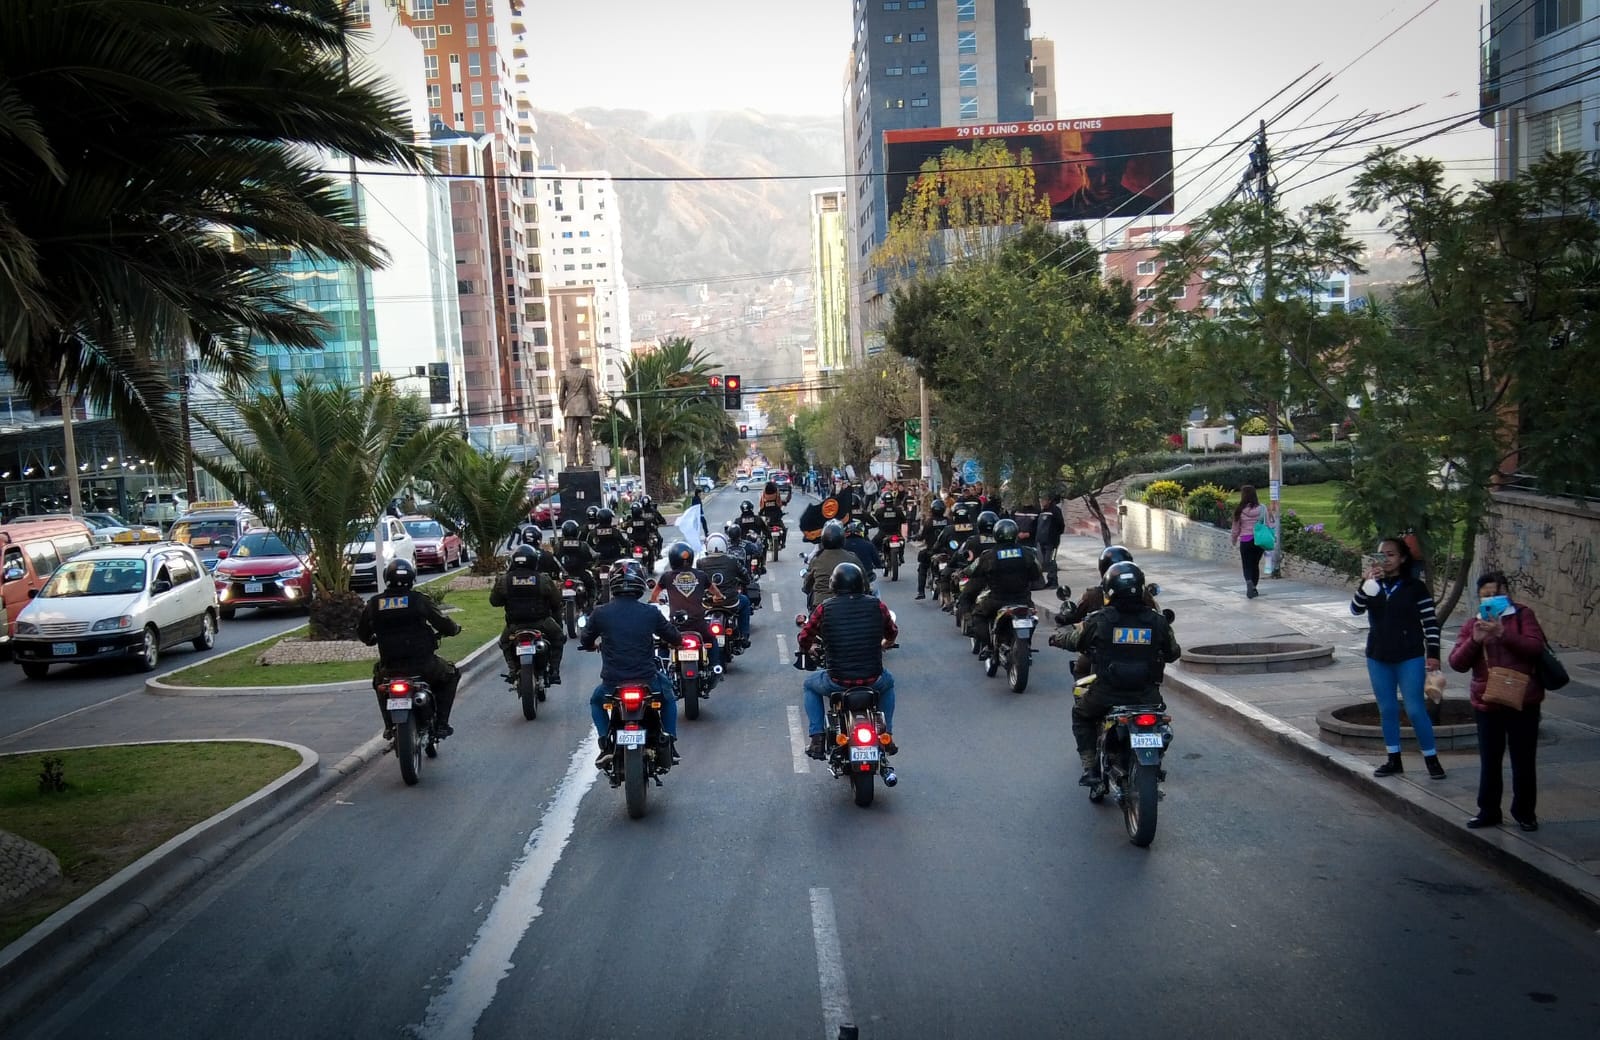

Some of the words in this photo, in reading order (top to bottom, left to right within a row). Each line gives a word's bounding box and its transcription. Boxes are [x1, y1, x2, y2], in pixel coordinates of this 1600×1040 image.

[957, 128, 970, 137] 29
[973, 127, 985, 136] DE
[988, 125, 1019, 135] JUNIO
[1028, 122, 1055, 132] SOLO
[1057, 121, 1071, 131] EN
[1073, 120, 1102, 130] CINES
[1113, 628, 1152, 645] P.A.C.
